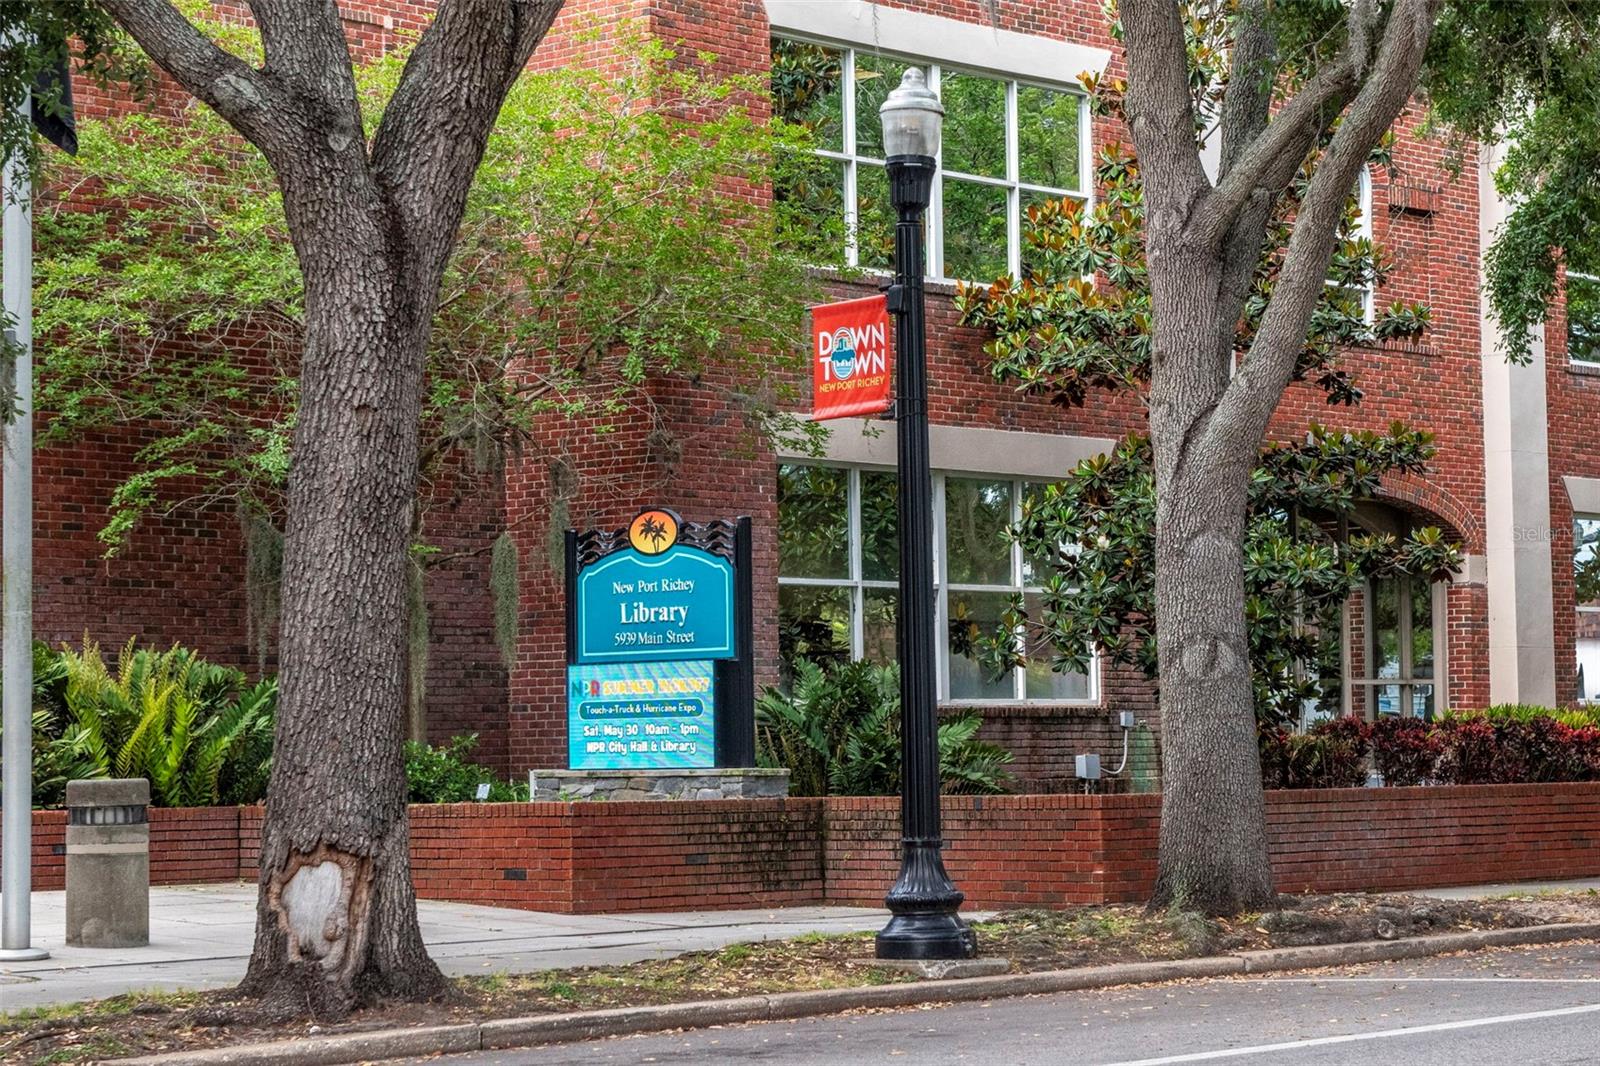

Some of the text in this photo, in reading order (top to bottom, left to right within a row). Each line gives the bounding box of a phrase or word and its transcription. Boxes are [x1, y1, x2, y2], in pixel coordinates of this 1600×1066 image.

[819, 322, 885, 356] DOWN
[819, 349, 886, 381] TOWN
[819, 376, 885, 393] NEW PORT RICHEY
[612, 578, 695, 595] New Port Richey
[620, 601, 689, 627] Library
[614, 630, 695, 646] 5939 Main Street
[571, 680, 600, 698] NPR
[586, 702, 697, 715] Touch-a-Truck & Hurricane Expo
[583, 725, 601, 736] Sat.
[603, 724, 623, 738] May
[625, 724, 638, 735] 30
[645, 723, 669, 735] 10am
[680, 722, 699, 736] 1pm
[586, 739, 697, 755] NPR City Hall & Library
